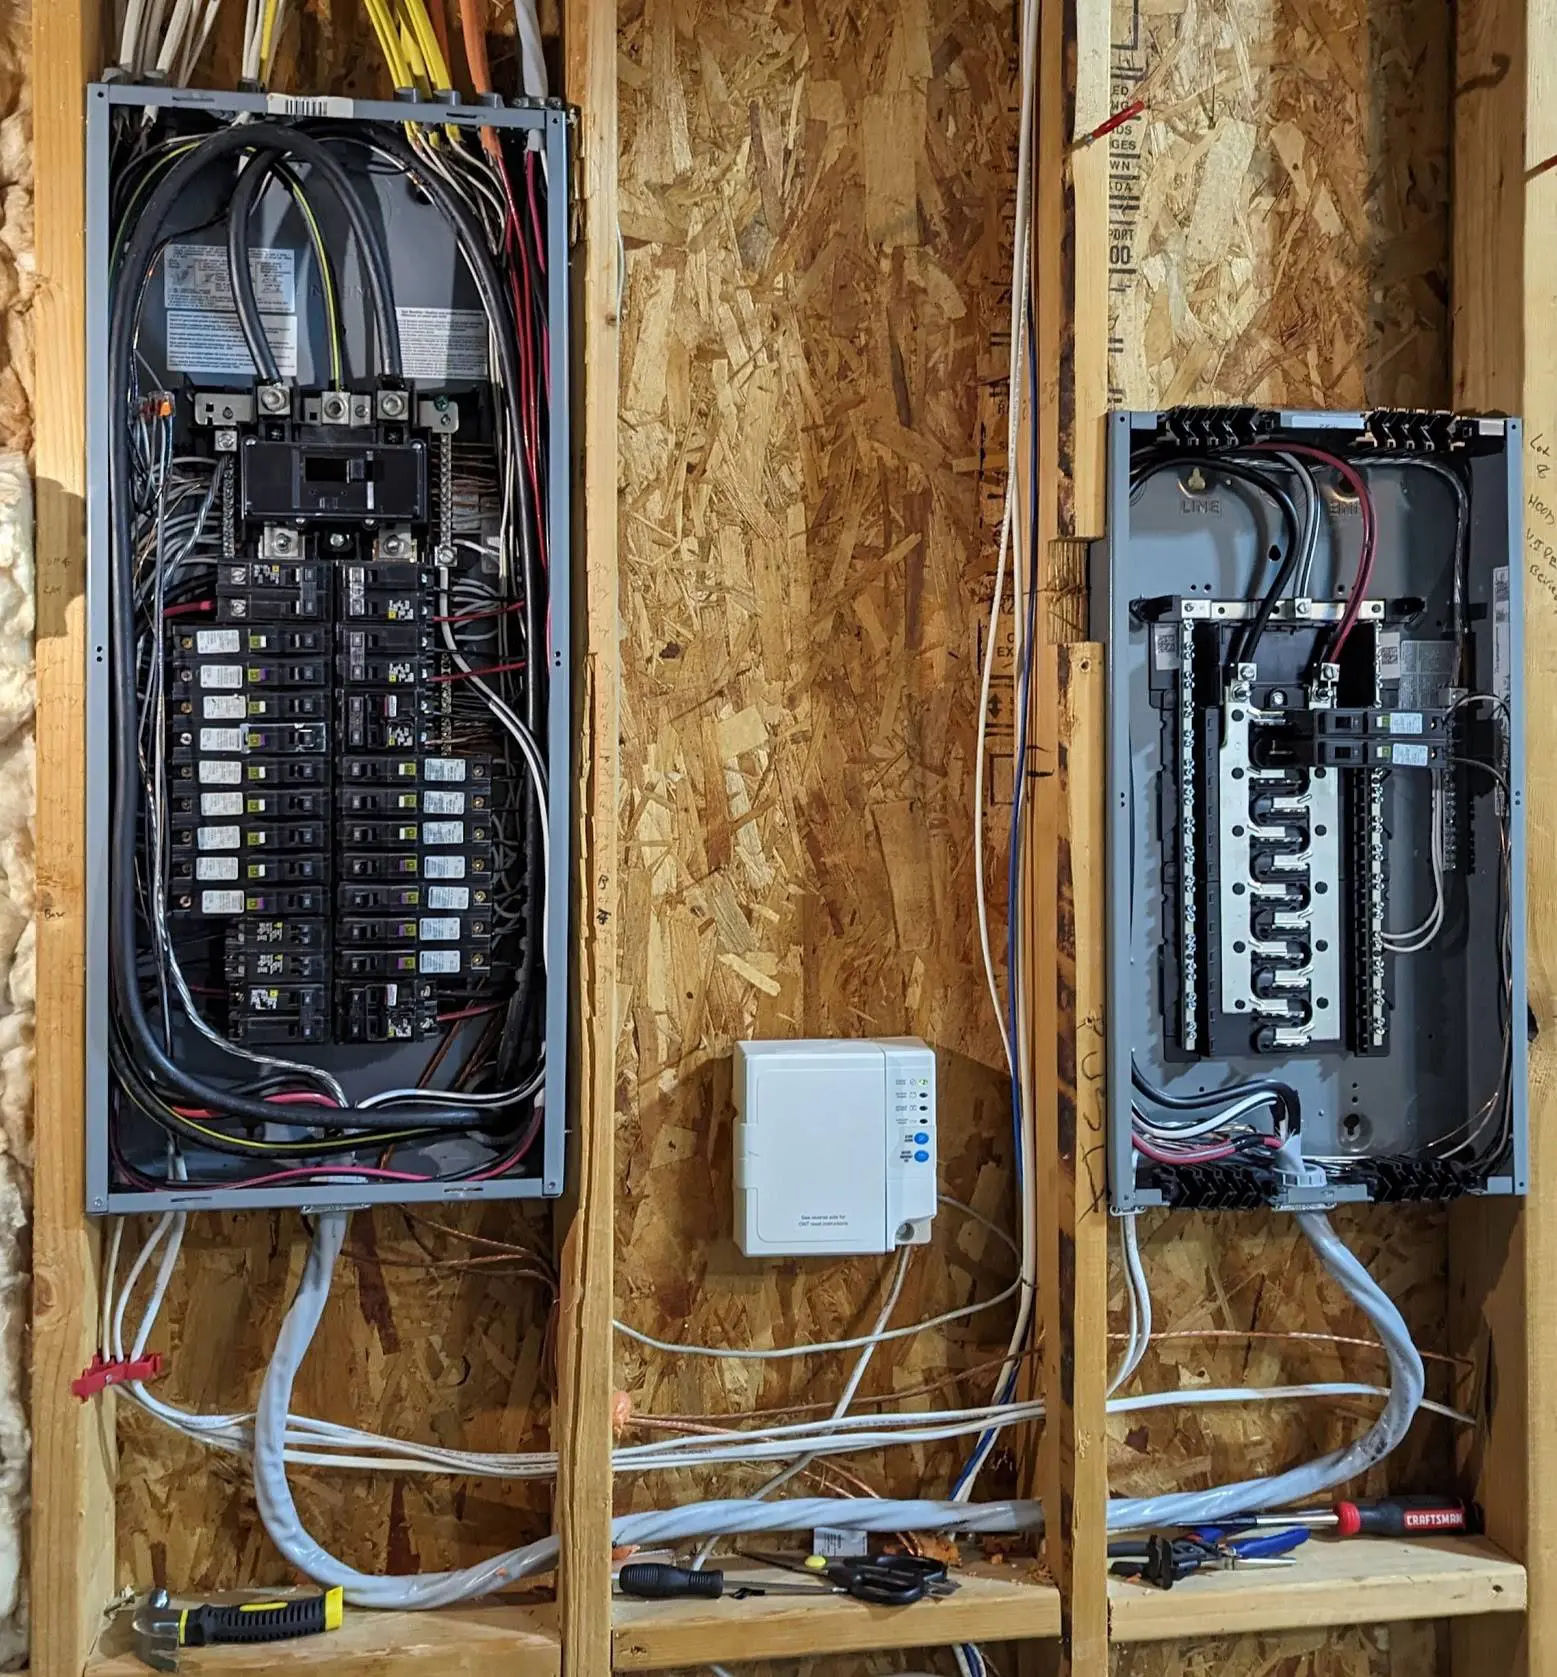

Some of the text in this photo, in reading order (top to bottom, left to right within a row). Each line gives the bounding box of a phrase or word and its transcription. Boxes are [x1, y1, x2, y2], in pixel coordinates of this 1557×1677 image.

[1111, 140, 1136, 150] GES
[1182, 500, 1221, 514] LINE
[1406, 1513, 1464, 1526] CRAFTSMAN
